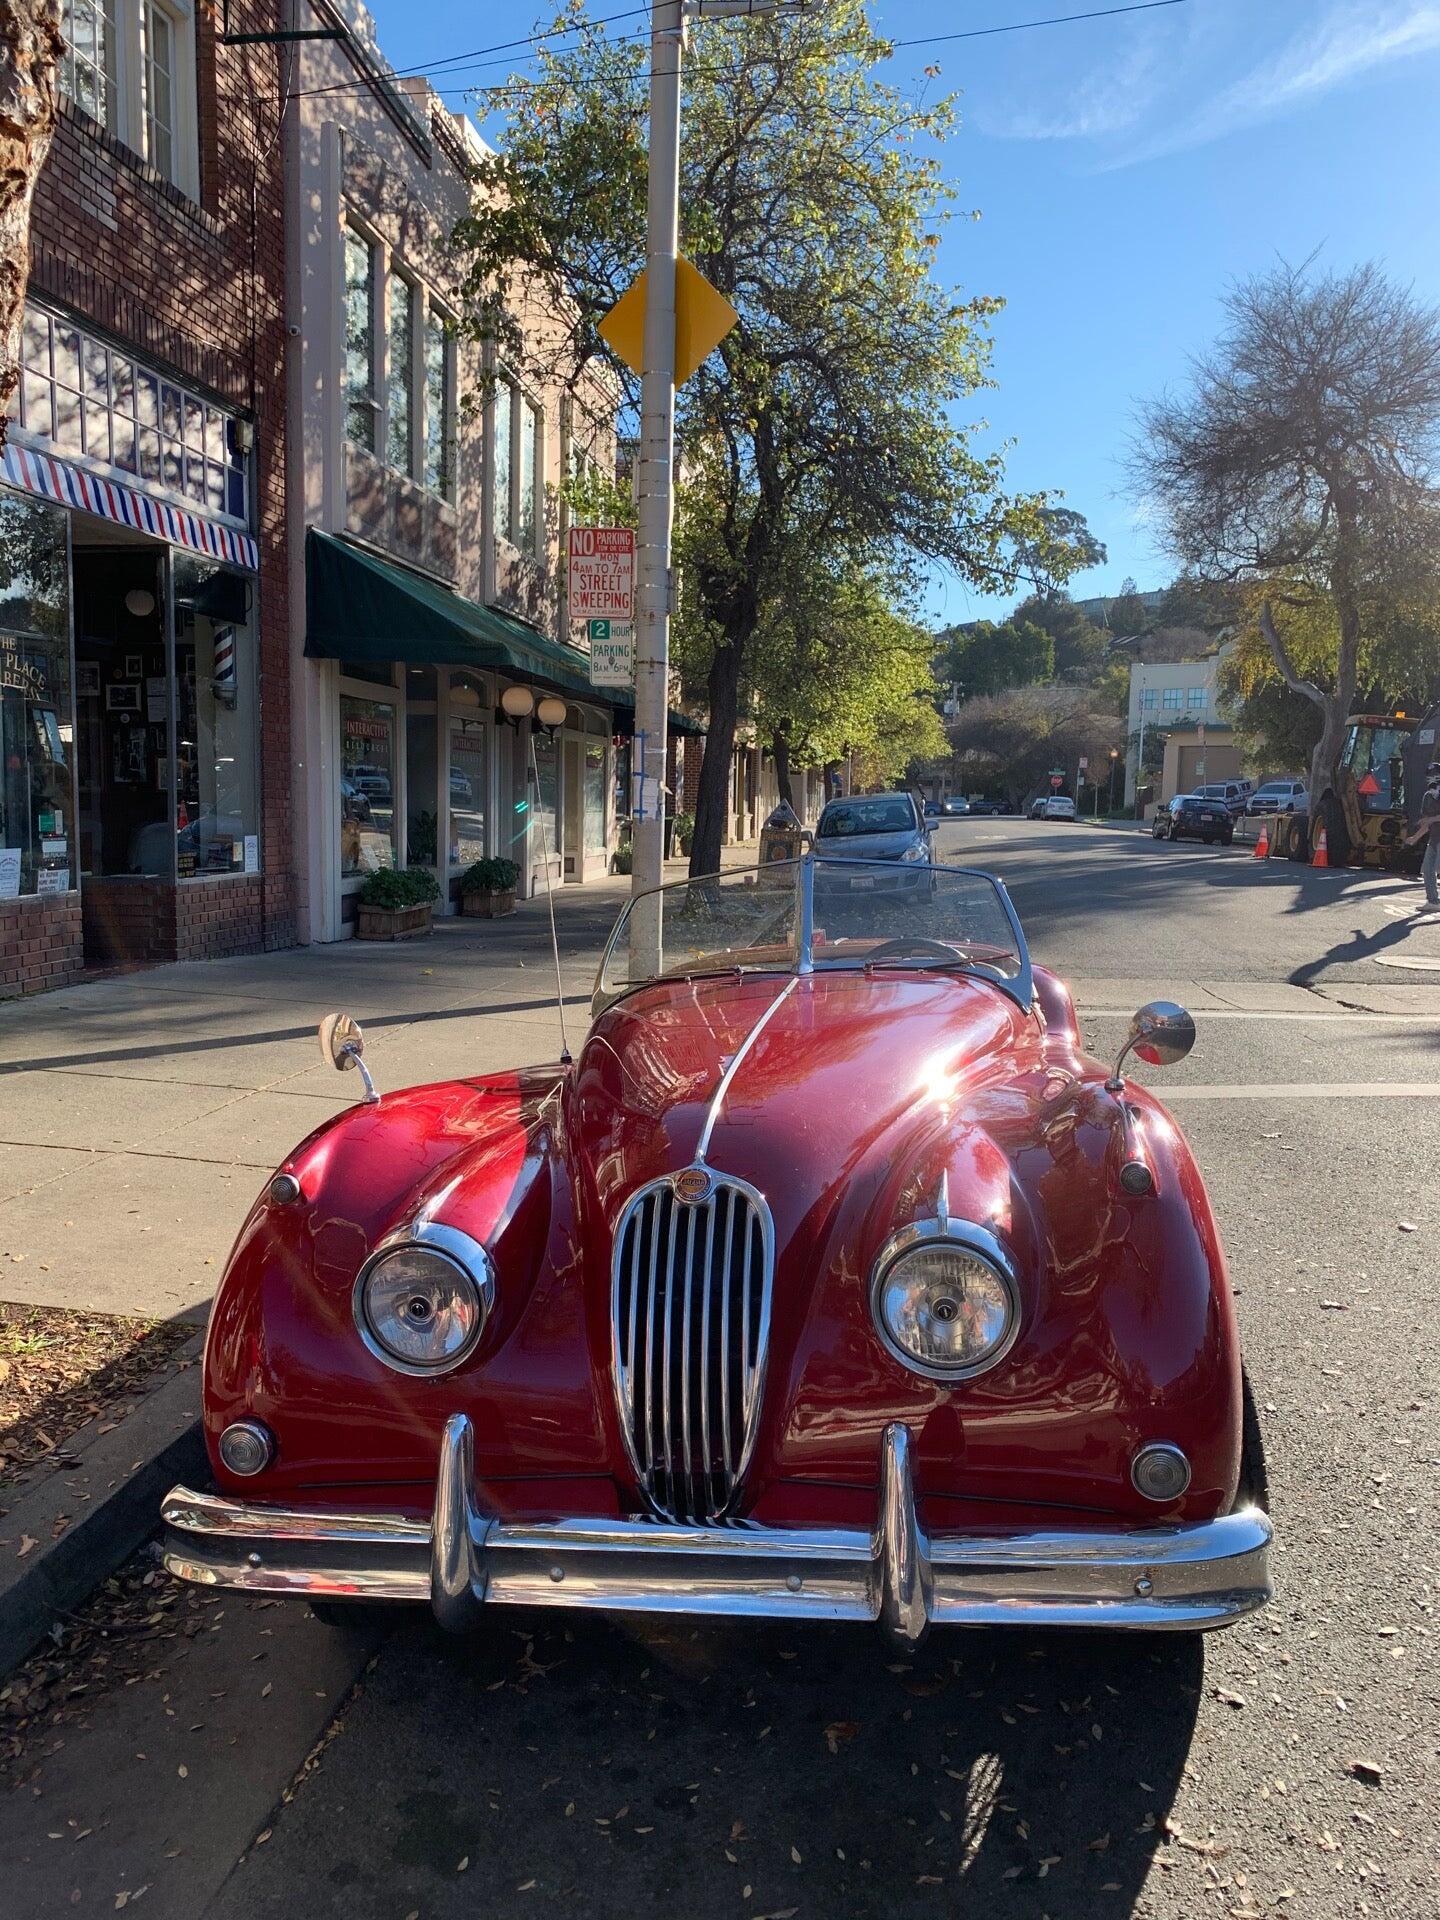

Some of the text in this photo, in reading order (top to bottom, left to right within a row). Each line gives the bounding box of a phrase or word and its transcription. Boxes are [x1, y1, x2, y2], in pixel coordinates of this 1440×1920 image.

[572, 530, 631, 555] NO PARKING
[600, 554, 619, 562] MON
[572, 561, 630, 574] 4AM TO 7AM
[580, 574, 621, 590] STREET
[572, 592, 629, 608] SWEEPING
[595, 621, 630, 637] 2 HOUR
[594, 645, 629, 657] PARKING
[6, 652, 46, 690] PLACE
[347, 719, 389, 738] INTERACTIVE
